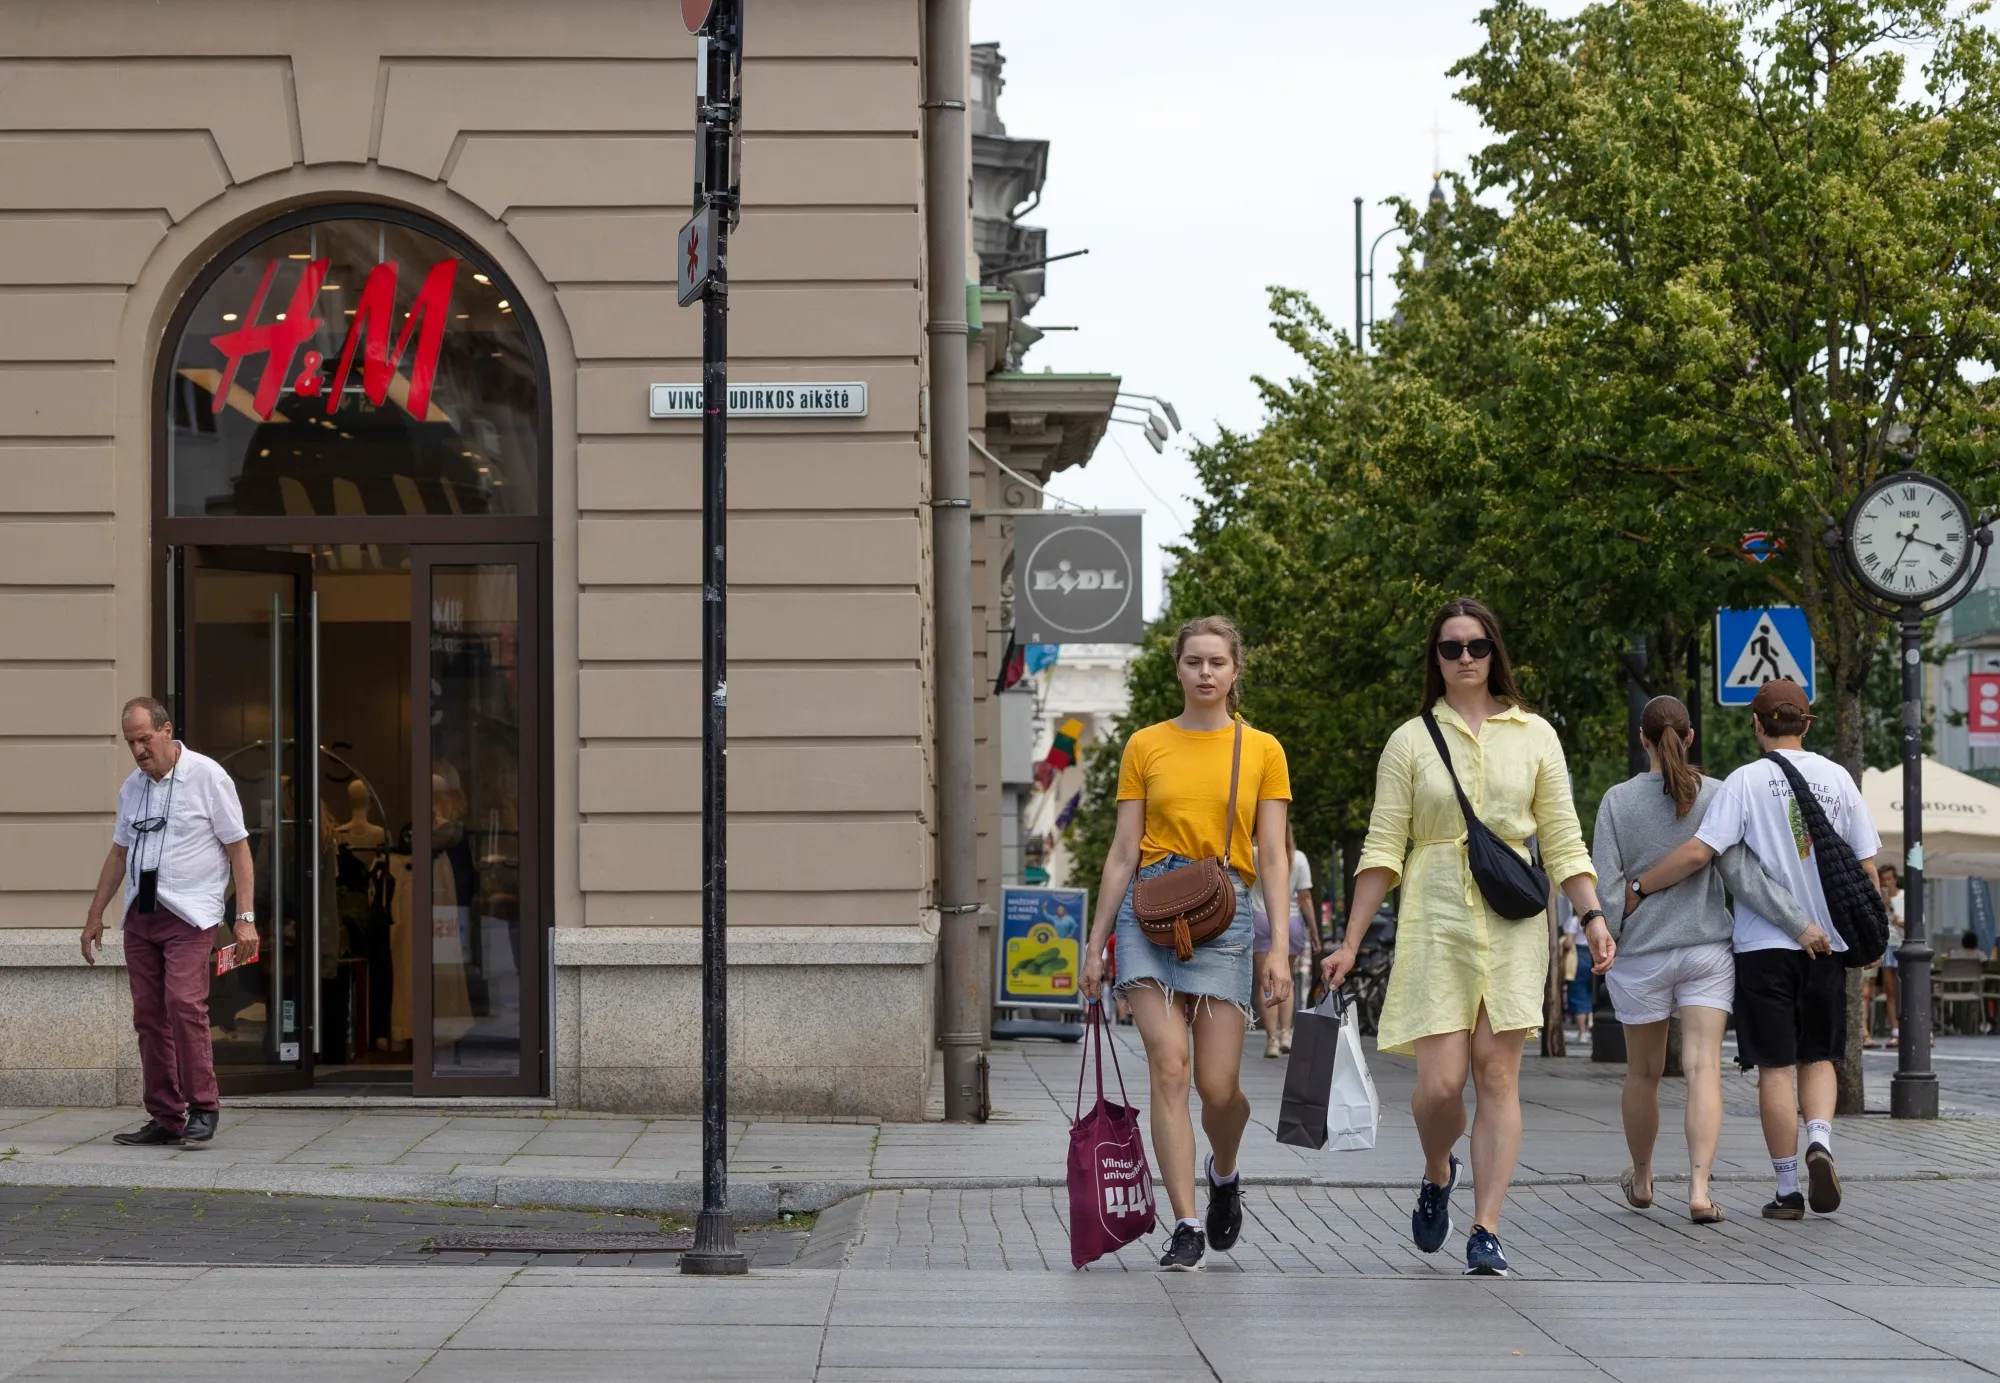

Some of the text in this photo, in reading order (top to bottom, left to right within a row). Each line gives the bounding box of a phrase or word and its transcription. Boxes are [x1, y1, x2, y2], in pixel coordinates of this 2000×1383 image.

[209, 257, 453, 421] H&M
[668, 388, 849, 409] VINC UDIRKOS aikštė
[1899, 510, 1921, 518] NERI
[1890, 801, 1987, 815] GRDON'S
